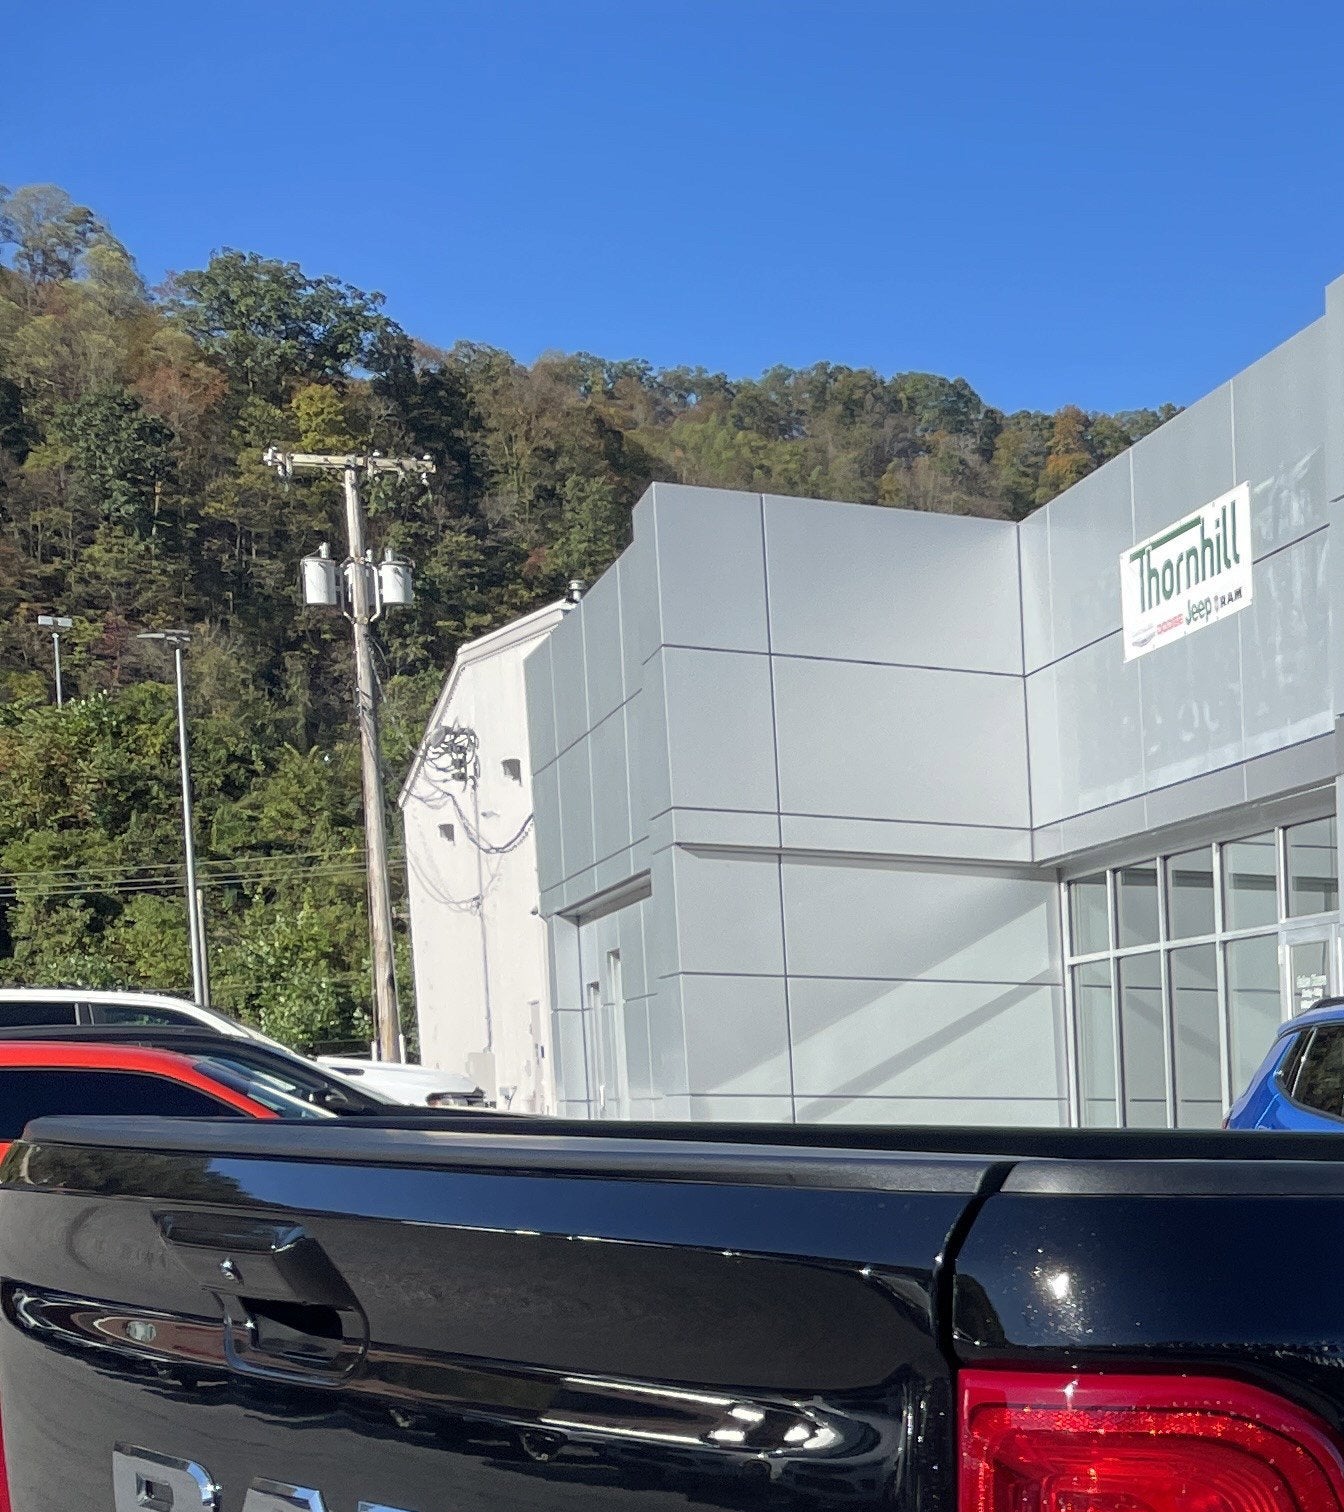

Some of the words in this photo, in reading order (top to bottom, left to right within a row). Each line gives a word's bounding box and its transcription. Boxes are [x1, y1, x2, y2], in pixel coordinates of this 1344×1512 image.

[1130, 500, 1240, 613] Thornhill
[1185, 596, 1212, 626] Jeep
[1220, 587, 1242, 609] RAM
